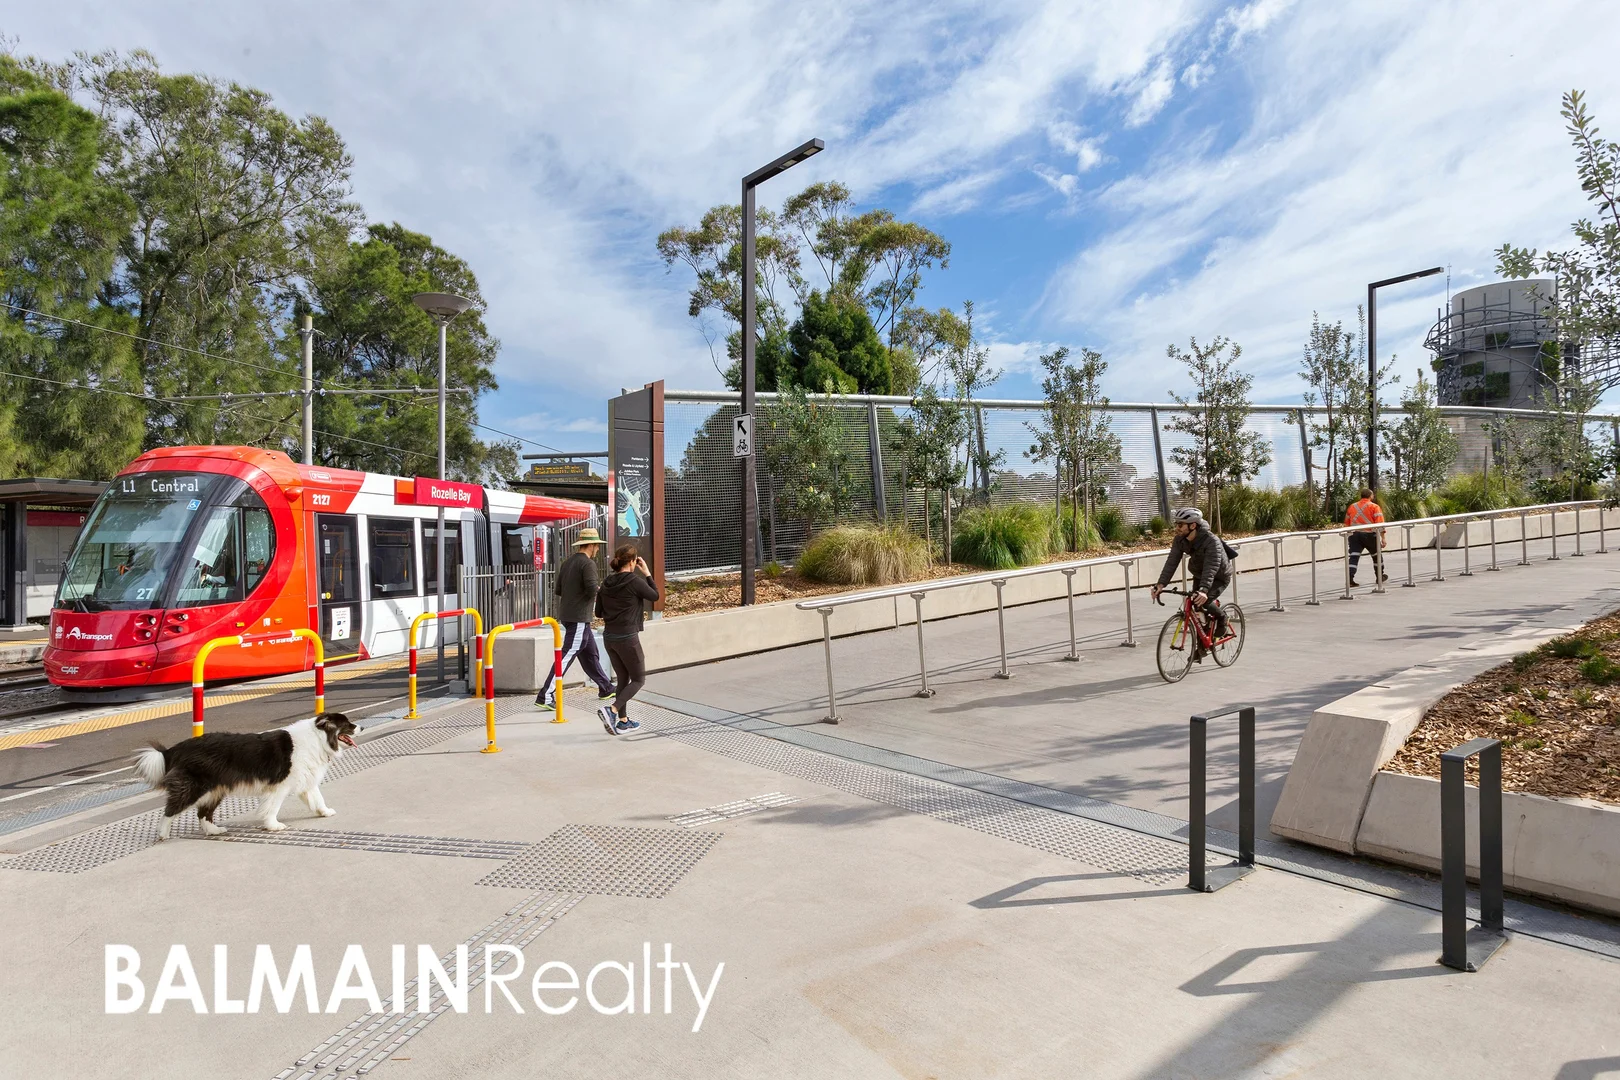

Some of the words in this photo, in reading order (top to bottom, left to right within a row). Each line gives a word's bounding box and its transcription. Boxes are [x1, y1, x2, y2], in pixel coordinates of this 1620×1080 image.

[122, 480, 136, 493] L1
[151, 479, 199, 493] Central
[312, 494, 331, 506] 2127
[431, 486, 458, 500] Rozelle
[458, 489, 471, 504] Bay
[136, 587, 154, 600] 27
[81, 632, 113, 641] Transport
